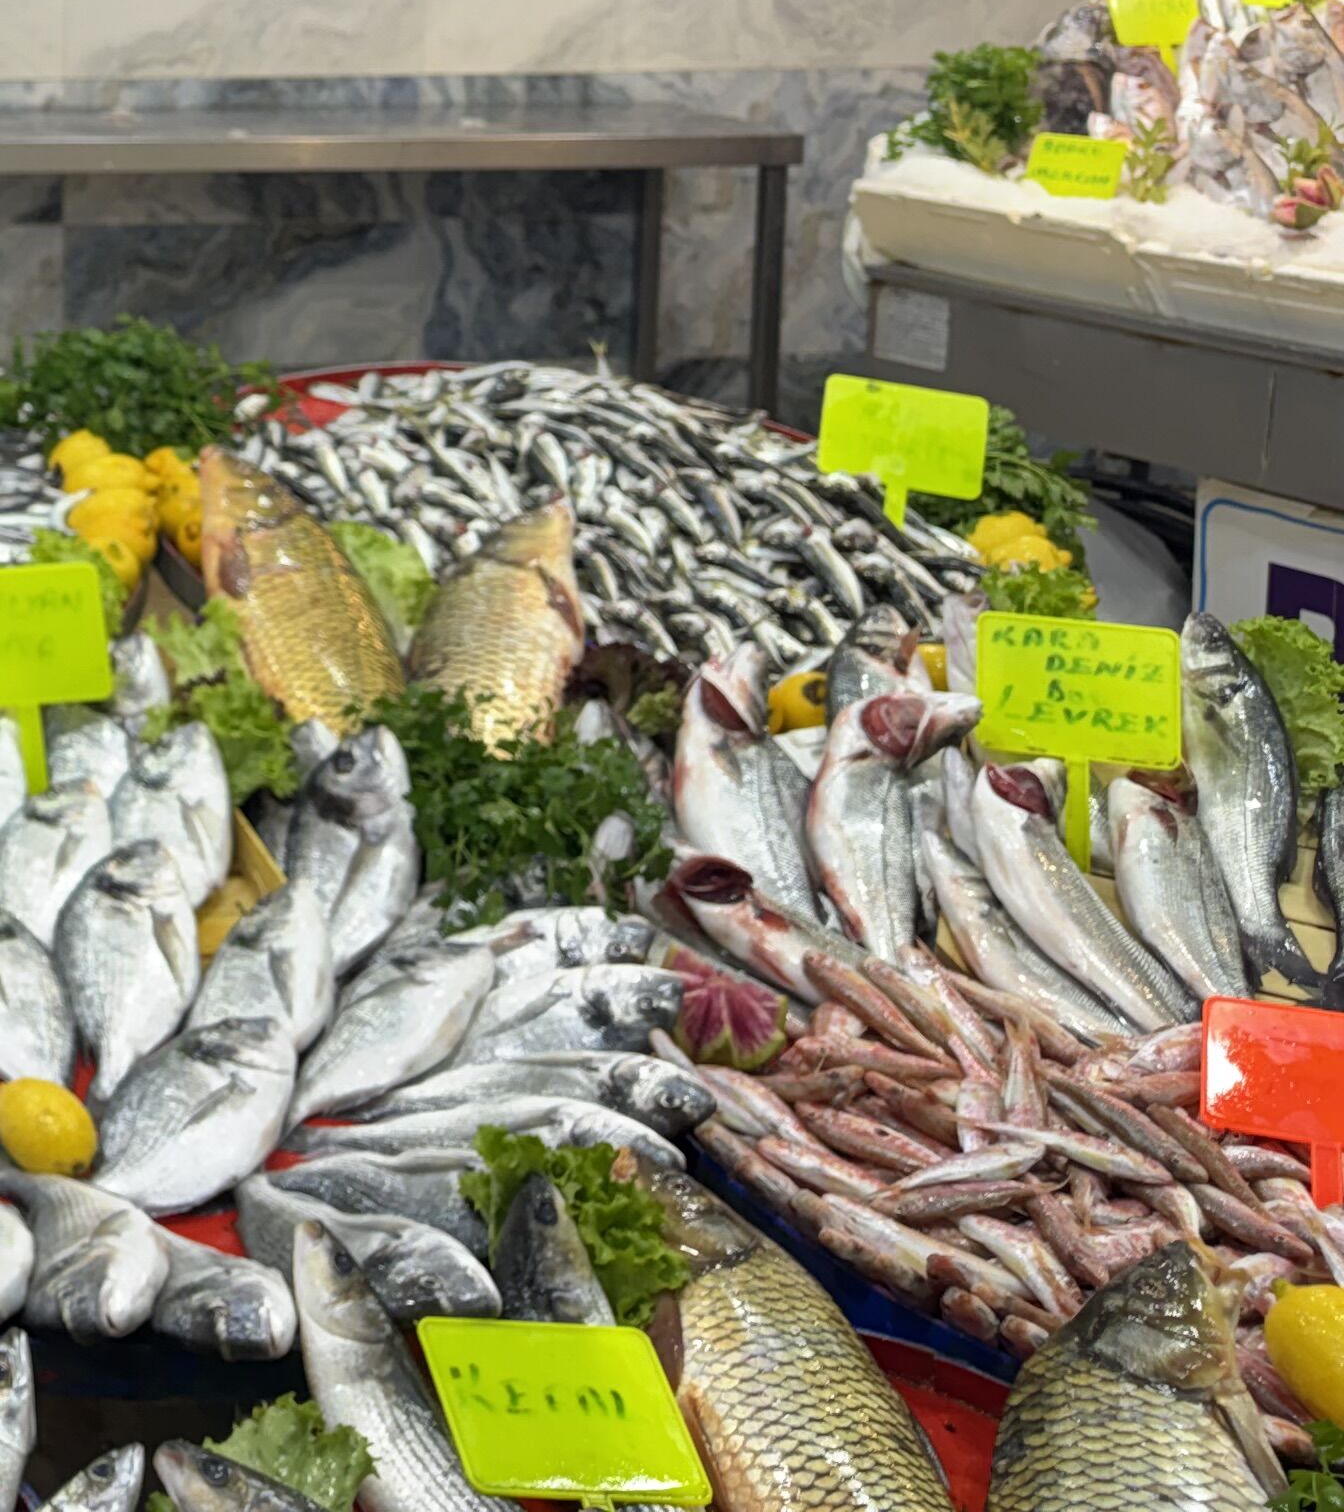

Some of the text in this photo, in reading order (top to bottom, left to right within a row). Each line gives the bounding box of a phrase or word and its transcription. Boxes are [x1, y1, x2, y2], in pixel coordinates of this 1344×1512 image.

[992, 624, 1101, 652] KARA
[1044, 652, 1165, 684] DENİZ
[996, 683, 1170, 739] LEVREK
